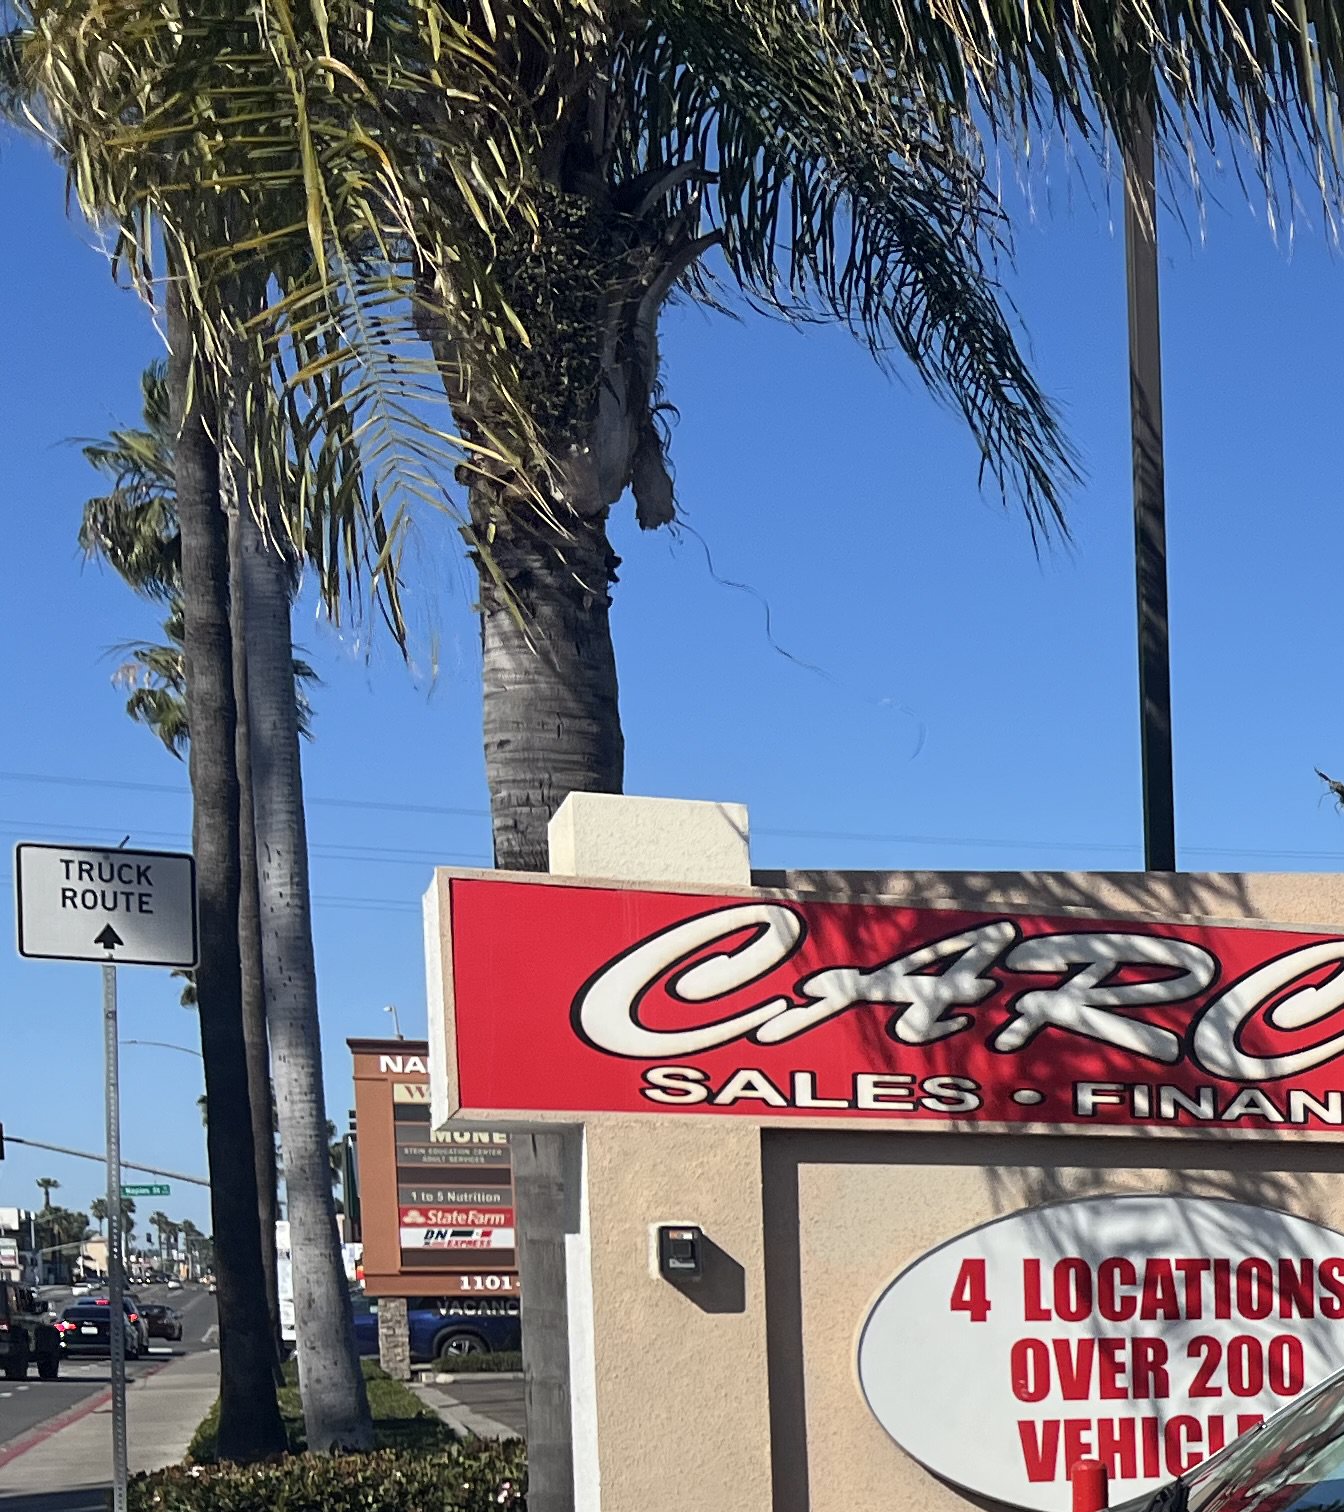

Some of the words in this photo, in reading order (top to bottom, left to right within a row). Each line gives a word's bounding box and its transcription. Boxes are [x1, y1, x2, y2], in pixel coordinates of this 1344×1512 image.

[59, 858, 154, 887] TRUCK
[61, 887, 154, 915] ROUTE
[379, 1055, 430, 1074] NA
[405, 1086, 431, 1099] W
[640, 1065, 987, 1113] SALES
[430, 1130, 508, 1144] MONE
[421, 1191, 434, 1203] to
[447, 1191, 501, 1203] Nutrition
[949, 1258, 992, 1322] 4
[437, 1300, 520, 1316] VACANC
[1010, 1336, 1170, 1403] OVER
[1186, 1334, 1305, 1398] 200
